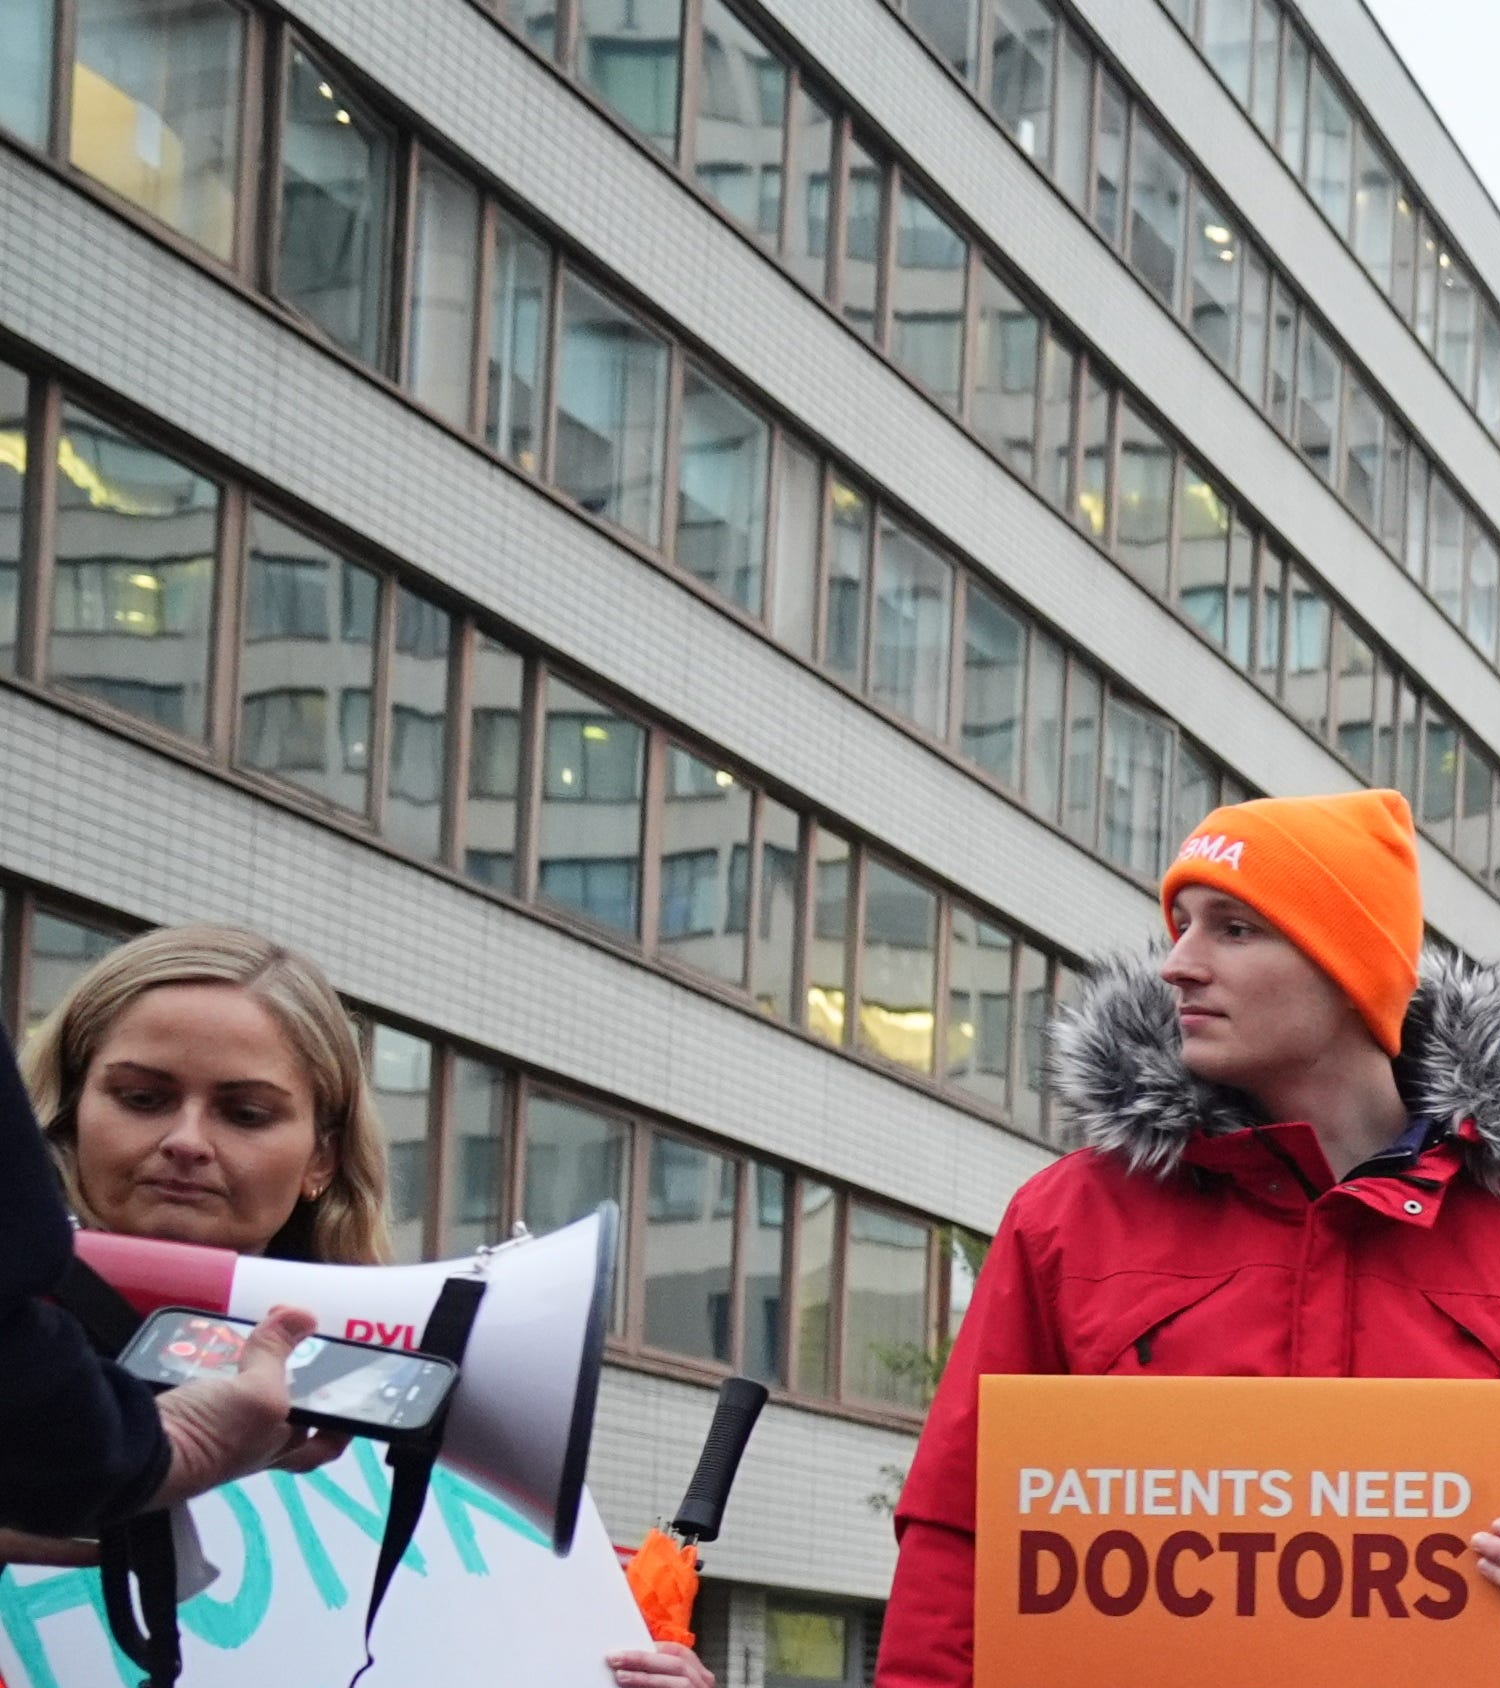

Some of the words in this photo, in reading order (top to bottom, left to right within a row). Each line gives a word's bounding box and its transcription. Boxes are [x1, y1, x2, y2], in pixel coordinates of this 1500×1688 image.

[1180, 833, 1246, 871] BMA
[1018, 1467, 1292, 1517] PATIENTS
[1311, 1472, 1471, 1519] NEED
[1017, 1531, 1470, 1621] DOCTORS
